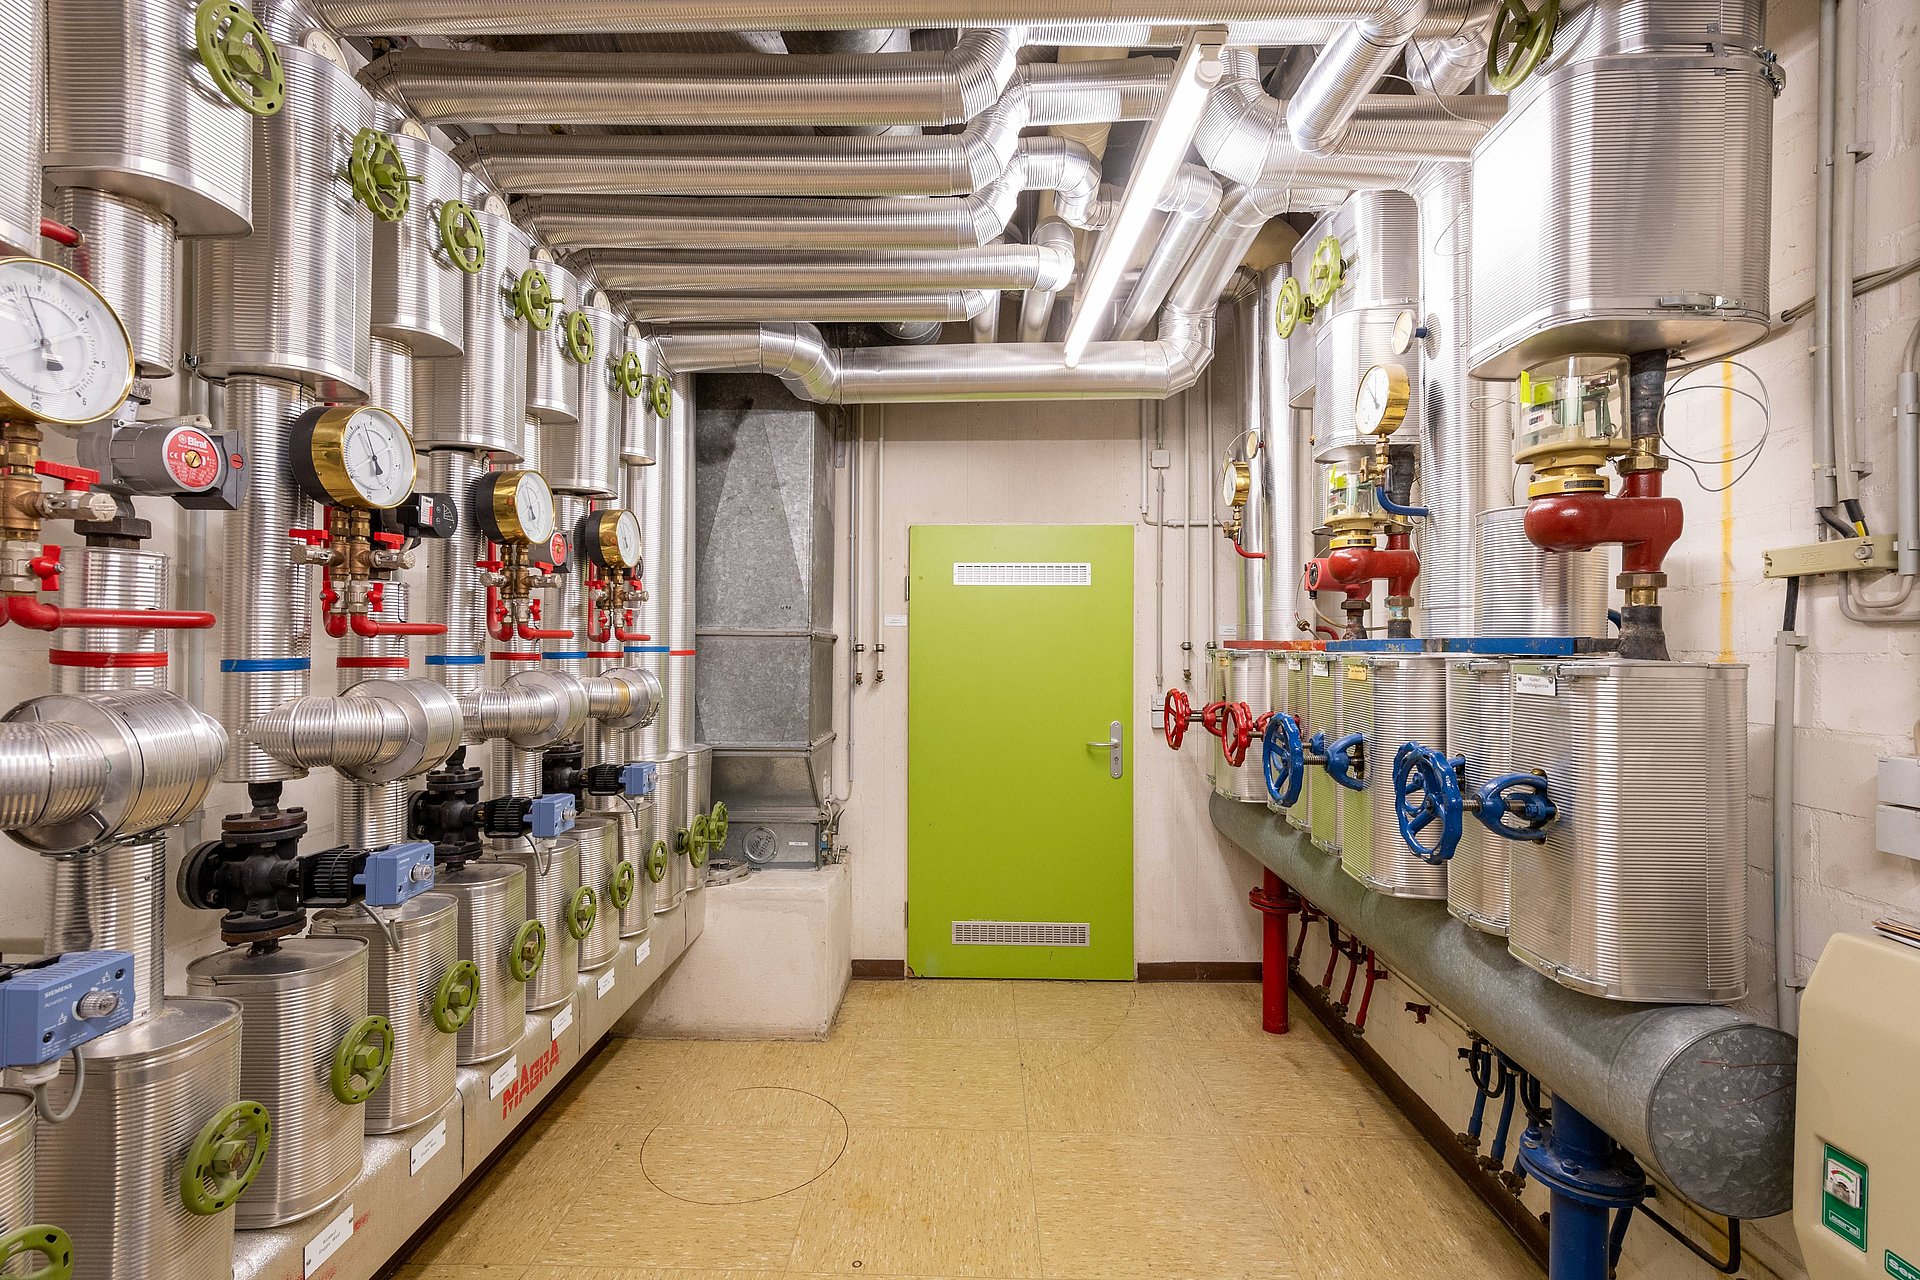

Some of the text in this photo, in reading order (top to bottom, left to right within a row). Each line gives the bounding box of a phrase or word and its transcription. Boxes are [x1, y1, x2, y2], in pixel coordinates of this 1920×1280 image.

[187, 436, 207, 449] Biral
[44, 983, 73, 998] SIEMENS
[502, 1039, 560, 1121] MAGRA
[1888, 1258, 1920, 1280] Ser
